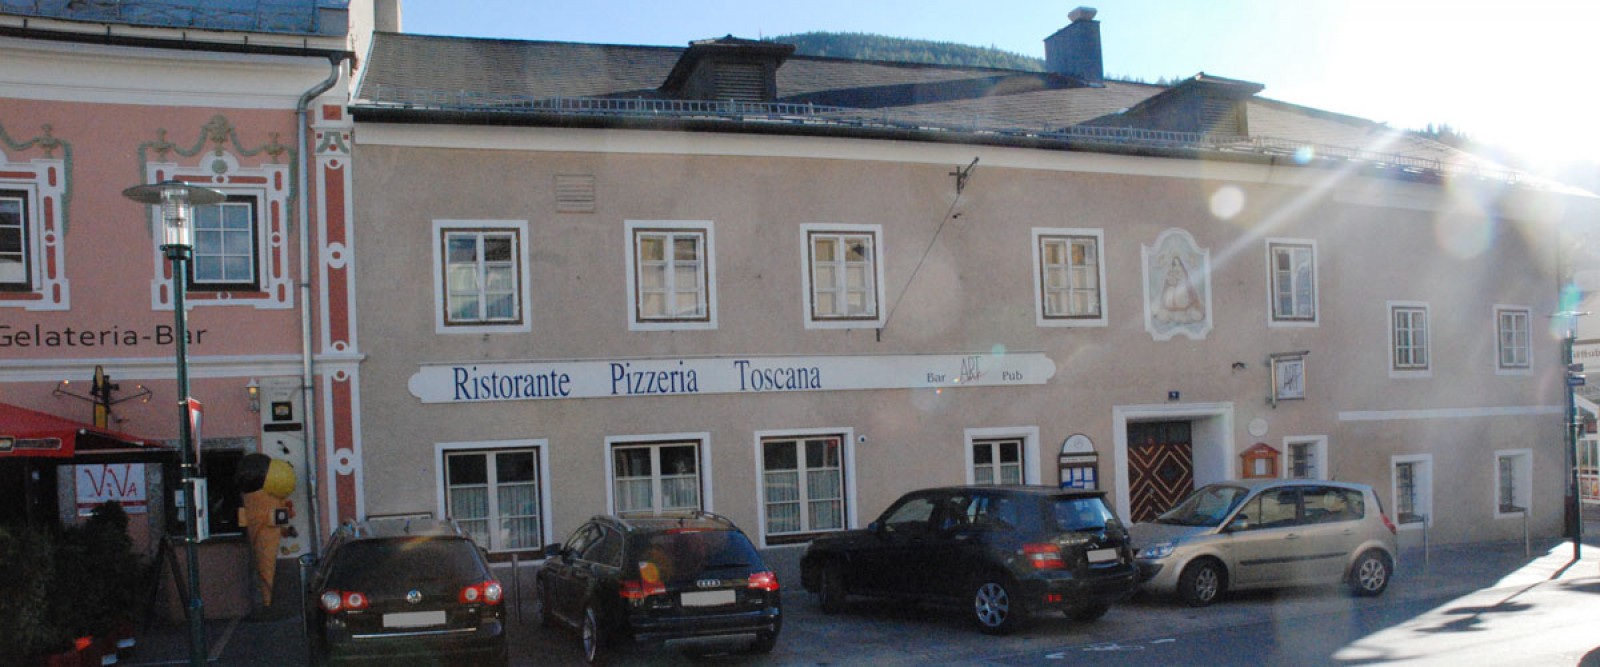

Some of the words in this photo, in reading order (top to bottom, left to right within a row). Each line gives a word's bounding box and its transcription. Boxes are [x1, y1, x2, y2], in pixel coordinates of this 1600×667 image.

[452, 366, 571, 400] Ristorante
[609, 361, 699, 395] Pizzeria
[734, 360, 822, 391] Toscana
[927, 372, 945, 383] Bar
[1002, 369, 1023, 381] Pub
